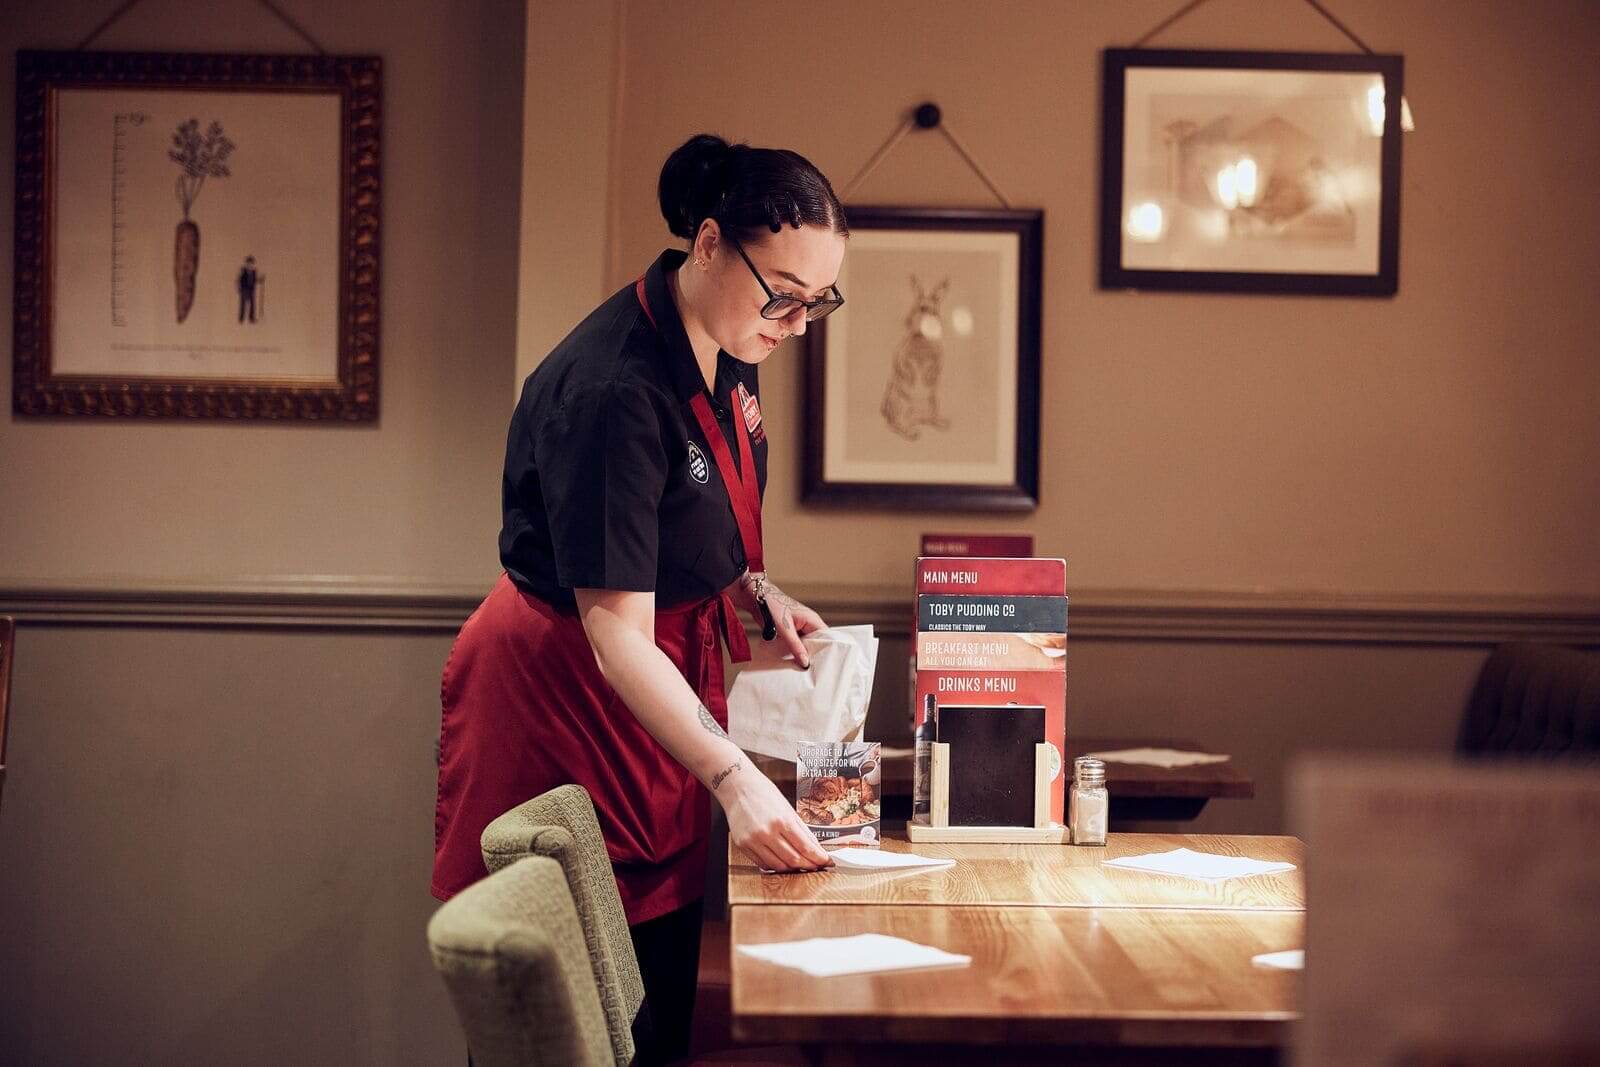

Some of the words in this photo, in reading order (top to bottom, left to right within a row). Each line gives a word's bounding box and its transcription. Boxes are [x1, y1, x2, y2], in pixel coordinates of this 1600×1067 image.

[923, 571, 948, 584] MAIN
[951, 572, 978, 584] MENU
[929, 603, 953, 616] TOBY
[957, 603, 1000, 617] PUDDING
[928, 623, 952, 631] CLASSICS
[925, 642, 979, 656] BREAKFAST
[982, 643, 1009, 656] MENU
[925, 656, 938, 666] ALL
[940, 656, 956, 666] YOU
[957, 656, 972, 666] CAN
[974, 656, 988, 666] EAT
[938, 677, 981, 692] DRINKS
[984, 677, 1016, 693] MENU
[801, 748, 833, 757] UPGRADE
[833, 748, 842, 757] TO
[843, 748, 849, 757] A
[800, 758, 819, 768] KING
[819, 758, 834, 768] SIZE
[835, 758, 849, 768] FOR
[849, 759, 859, 768] AN
[801, 769, 822, 778] EXTRA
